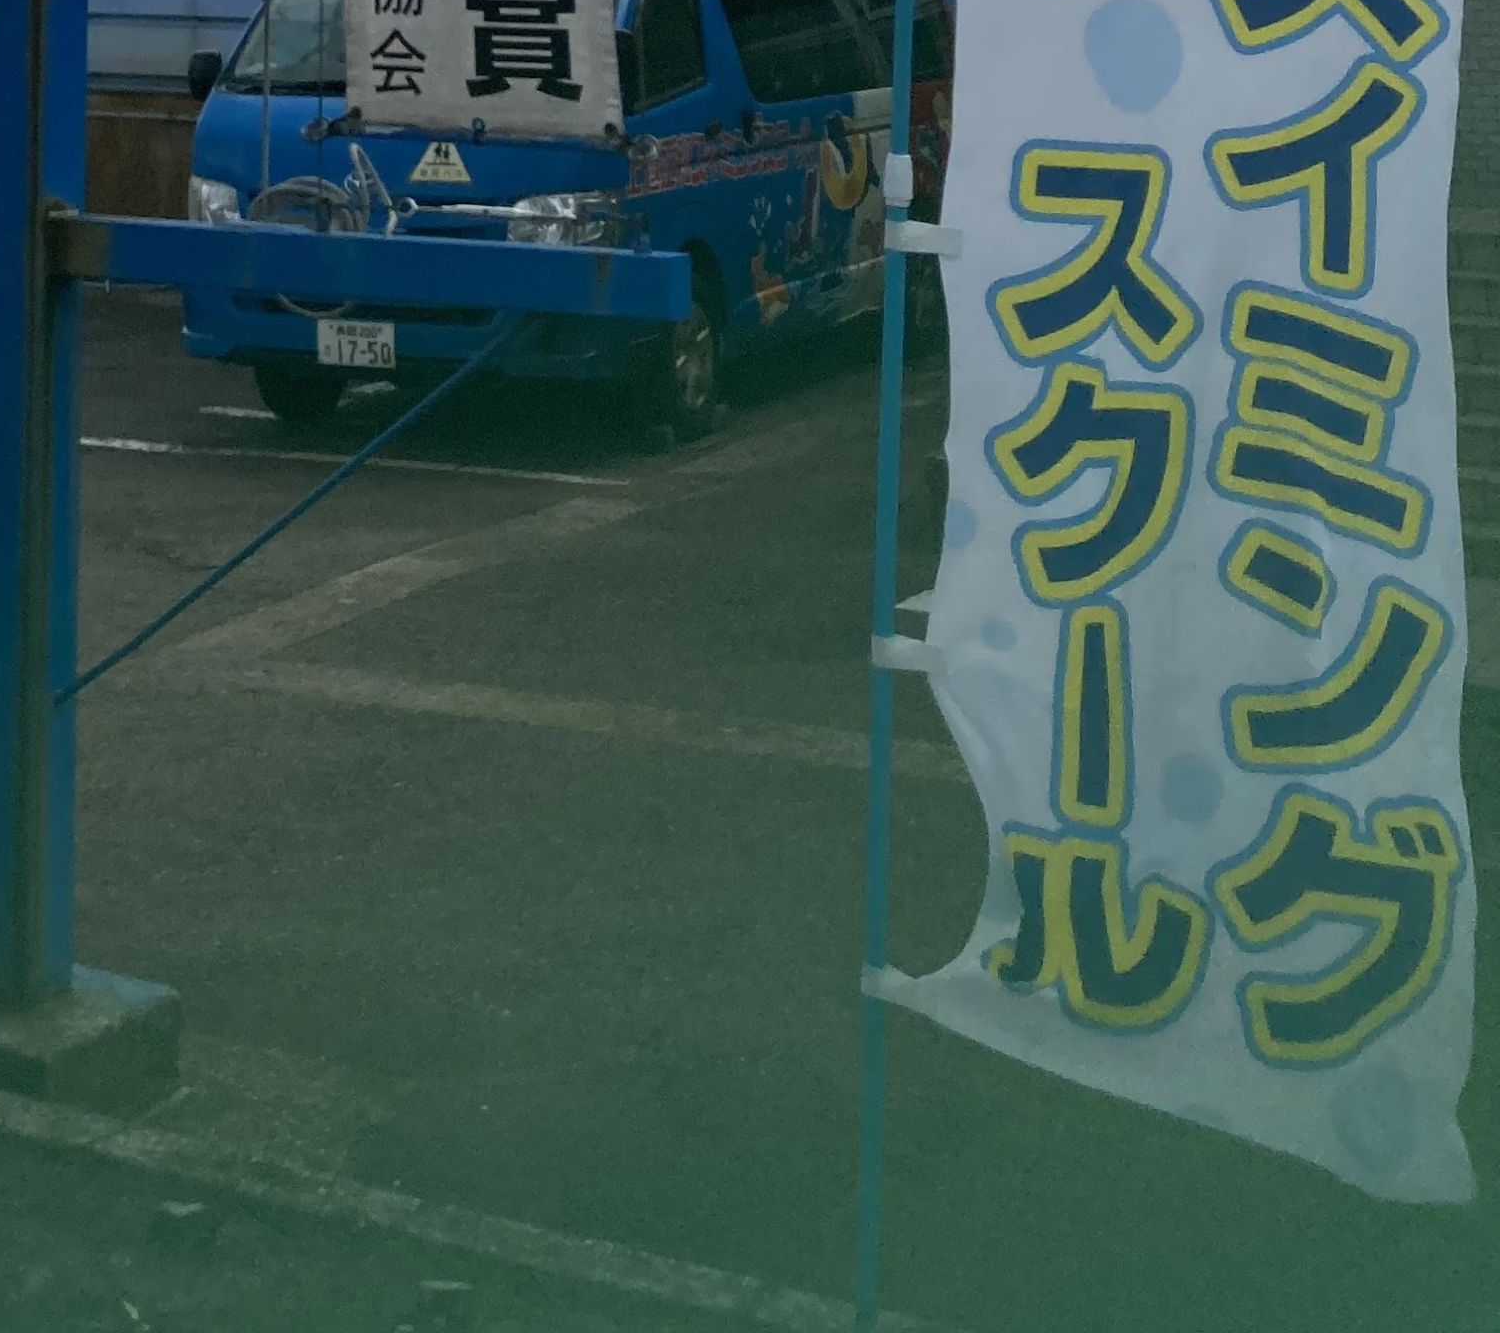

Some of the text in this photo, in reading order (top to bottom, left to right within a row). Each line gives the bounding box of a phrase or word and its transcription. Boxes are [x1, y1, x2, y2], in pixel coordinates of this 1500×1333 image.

[337, 340, 392, 366] 17-50
[981, 138, 1210, 1037] スクール
